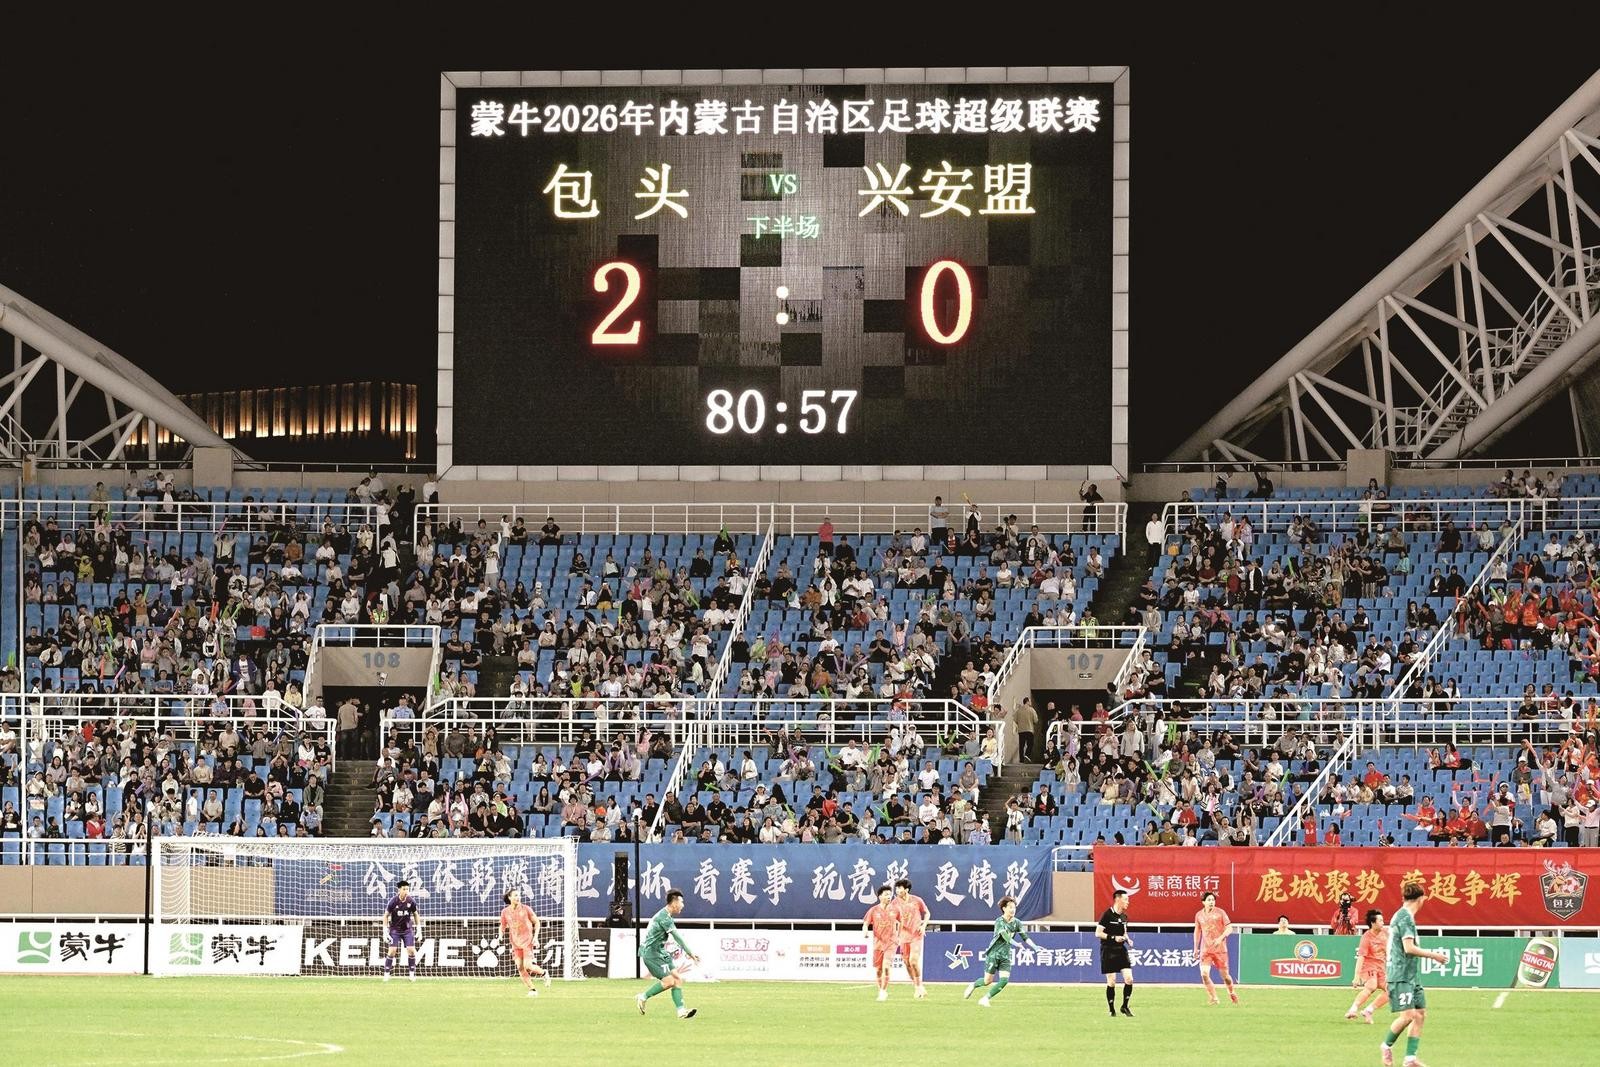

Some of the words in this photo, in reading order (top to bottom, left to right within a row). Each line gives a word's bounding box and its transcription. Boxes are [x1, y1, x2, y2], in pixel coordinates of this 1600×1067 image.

[470, 96, 1101, 137] 蒙牛2026年内蒙古自治区足球超级联赛
[769, 173, 798, 197] VS
[858, 160, 1036, 218] 兴安盟
[746, 215, 820, 241] 下半场
[591, 262, 642, 345] 2
[920, 260, 973, 344] 0
[705, 389, 858, 435] 80:57
[363, 653, 400, 668] 108
[1067, 654, 1103, 670] 107
[362, 857, 672, 904] 公益体彩燃情世杯
[693, 857, 793, 905] 看赛事
[811, 858, 909, 902] 玩竞彩
[934, 858, 1032, 906] 更精彩
[1147, 875, 1220, 890] 蒙商银行
[1255, 868, 1385, 905] 鹿城聚势
[59, 931, 125, 964] 蒙牛
[211, 933, 278, 966] 蒙牛
[533, 939, 607, 968] 尔美
[979, 948, 1093, 967] 体育彩票
[1127, 948, 1215, 968] 家公益彩
[1276, 962, 1337, 975] TSINGTAO
[1398, 992, 1413, 1005] 27
